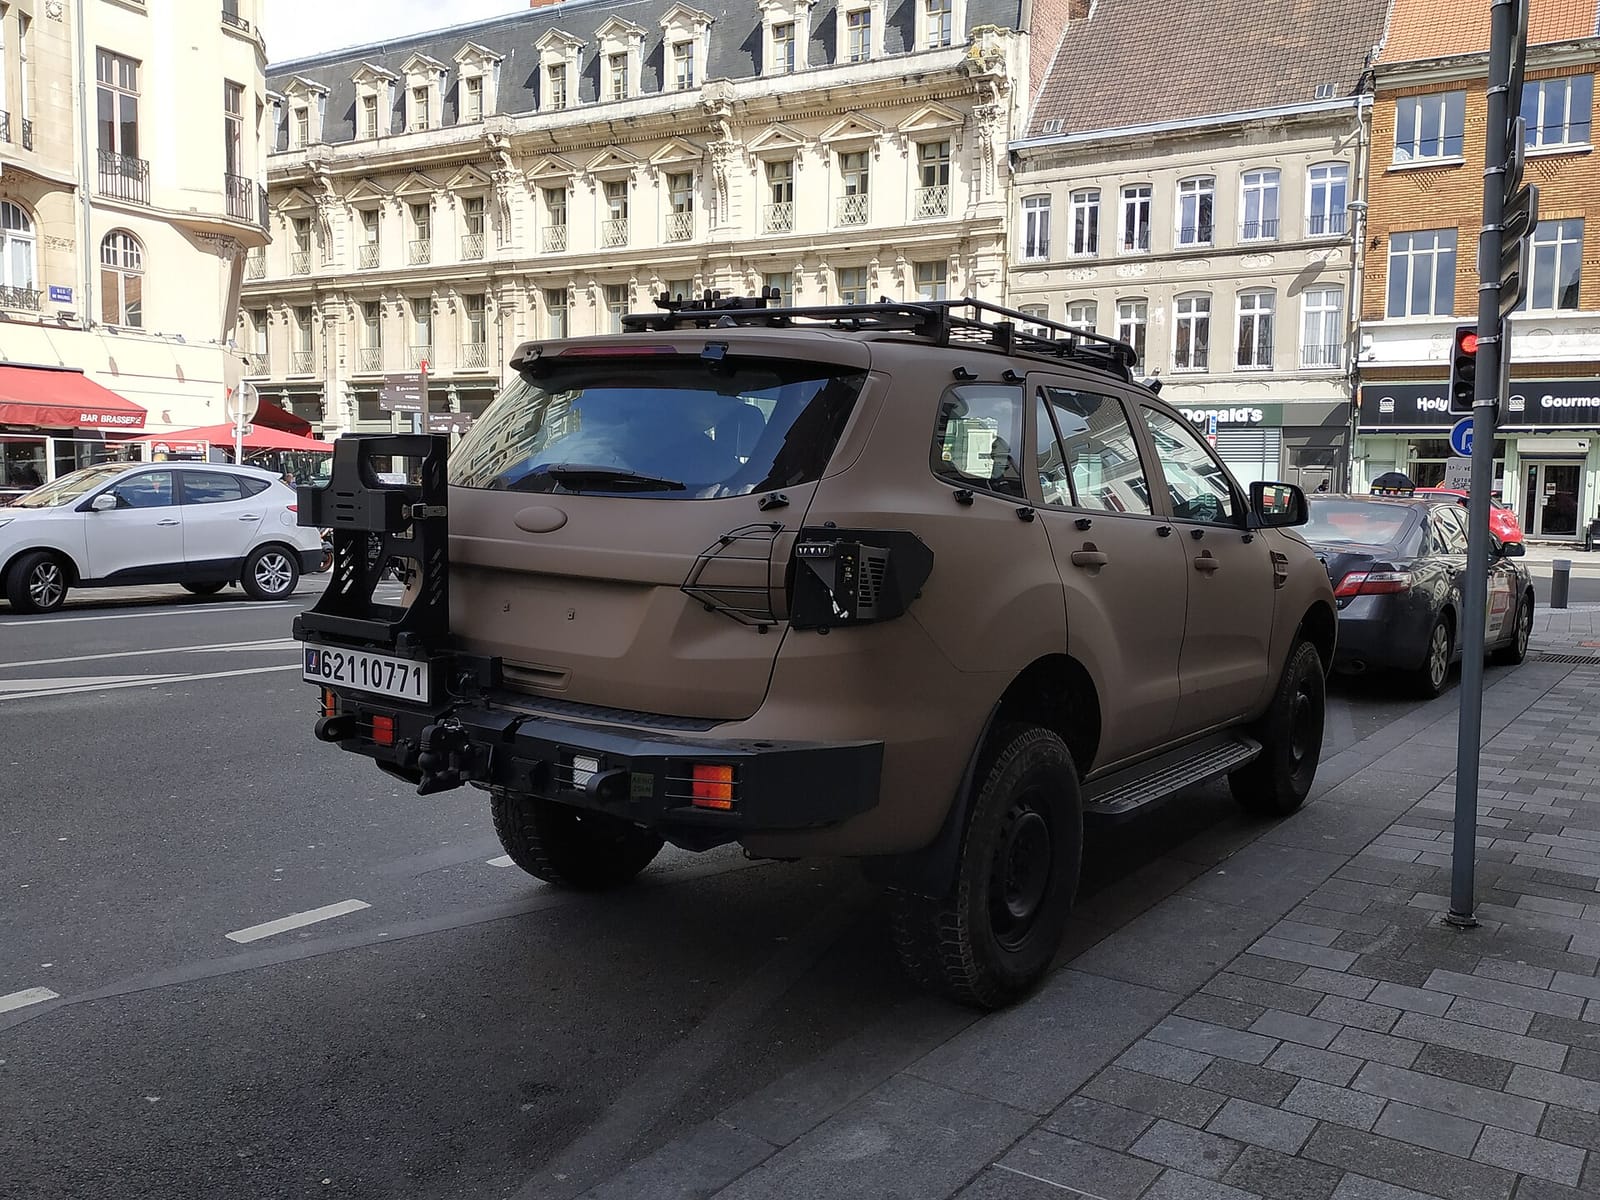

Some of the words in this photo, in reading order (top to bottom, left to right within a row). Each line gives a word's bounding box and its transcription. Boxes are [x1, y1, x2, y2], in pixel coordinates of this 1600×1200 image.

[1416, 396, 1449, 412] Holy
[1540, 394, 1600, 408] Gourme
[80, 413, 98, 423] BAR
[100, 414, 142, 424] BRASSERIE
[321, 650, 421, 696] 62110771
